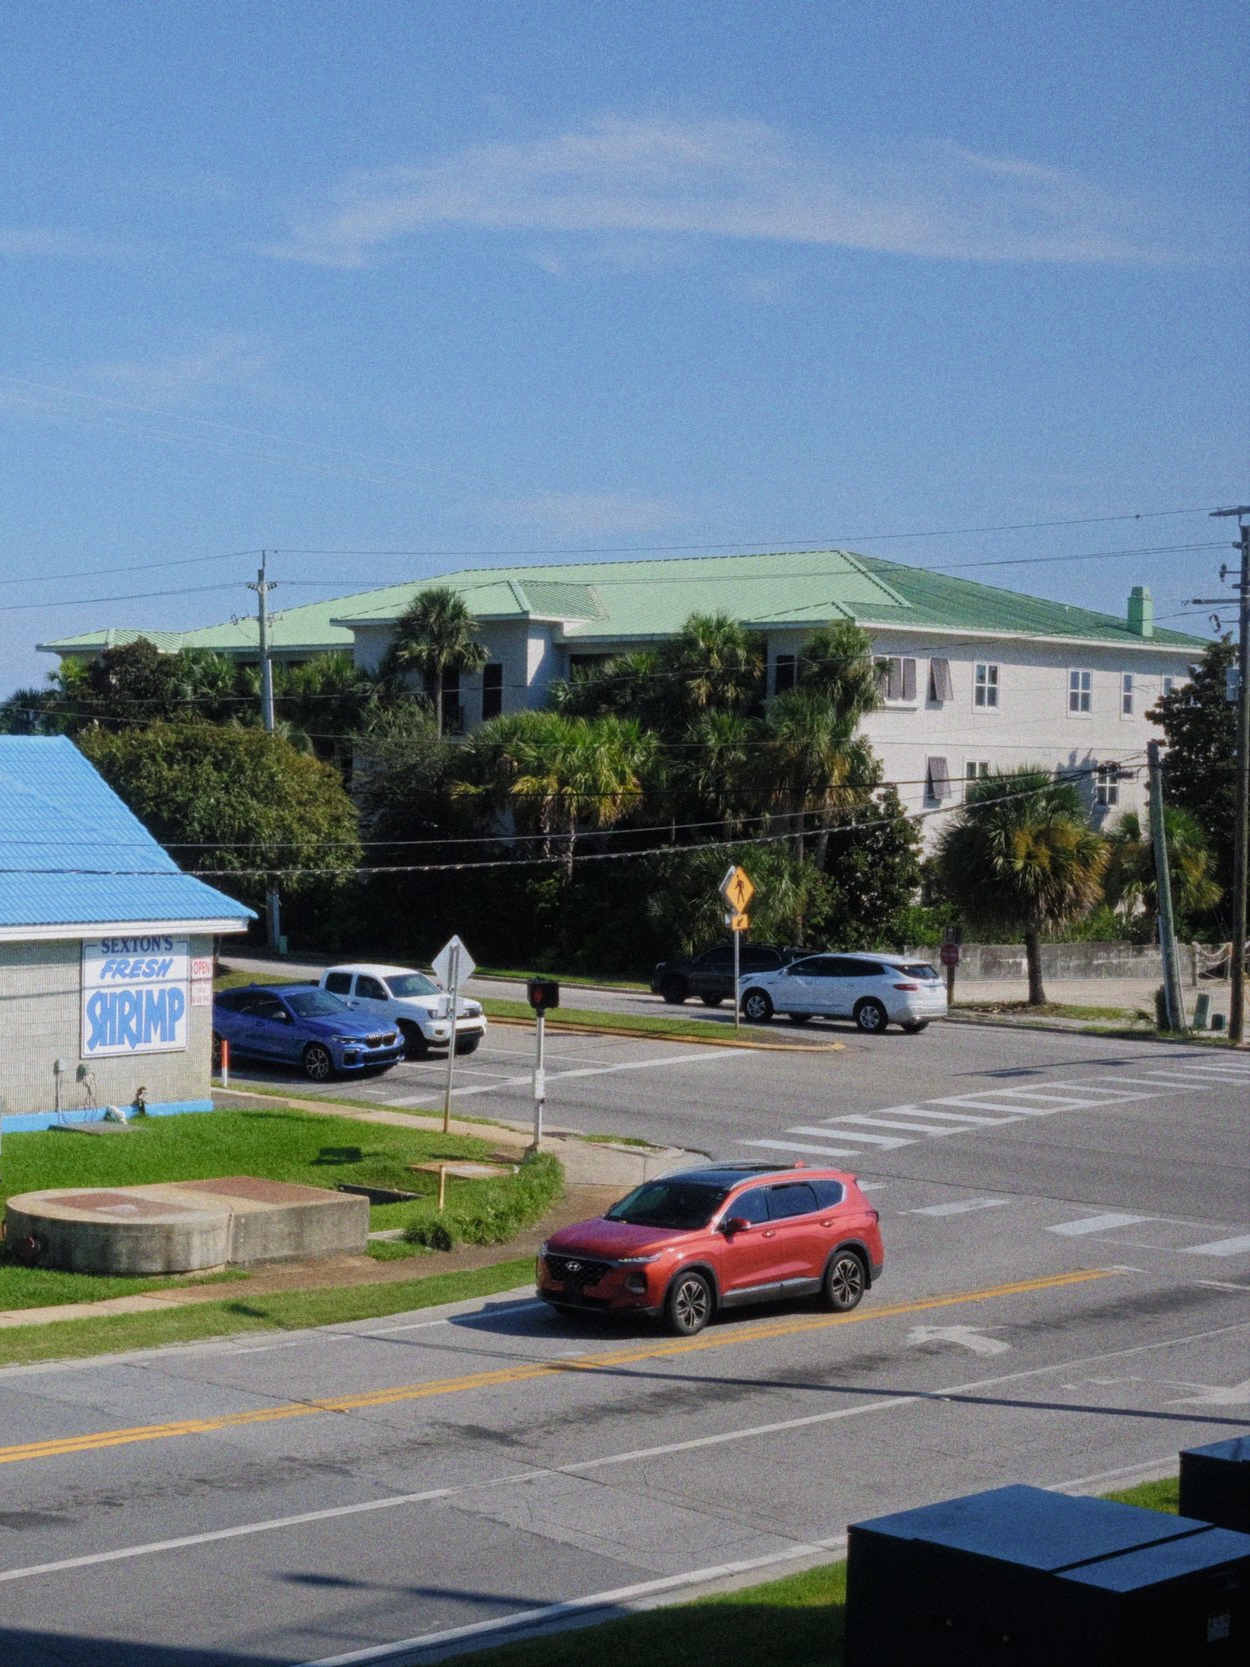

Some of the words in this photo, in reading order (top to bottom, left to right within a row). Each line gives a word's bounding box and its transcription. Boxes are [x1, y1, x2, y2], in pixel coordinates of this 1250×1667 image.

[101, 935, 173, 954] SEXTON'S
[100, 958, 173, 979] FRESH
[193, 961, 210, 975] OPEN
[87, 987, 185, 1051] SHRIMP
